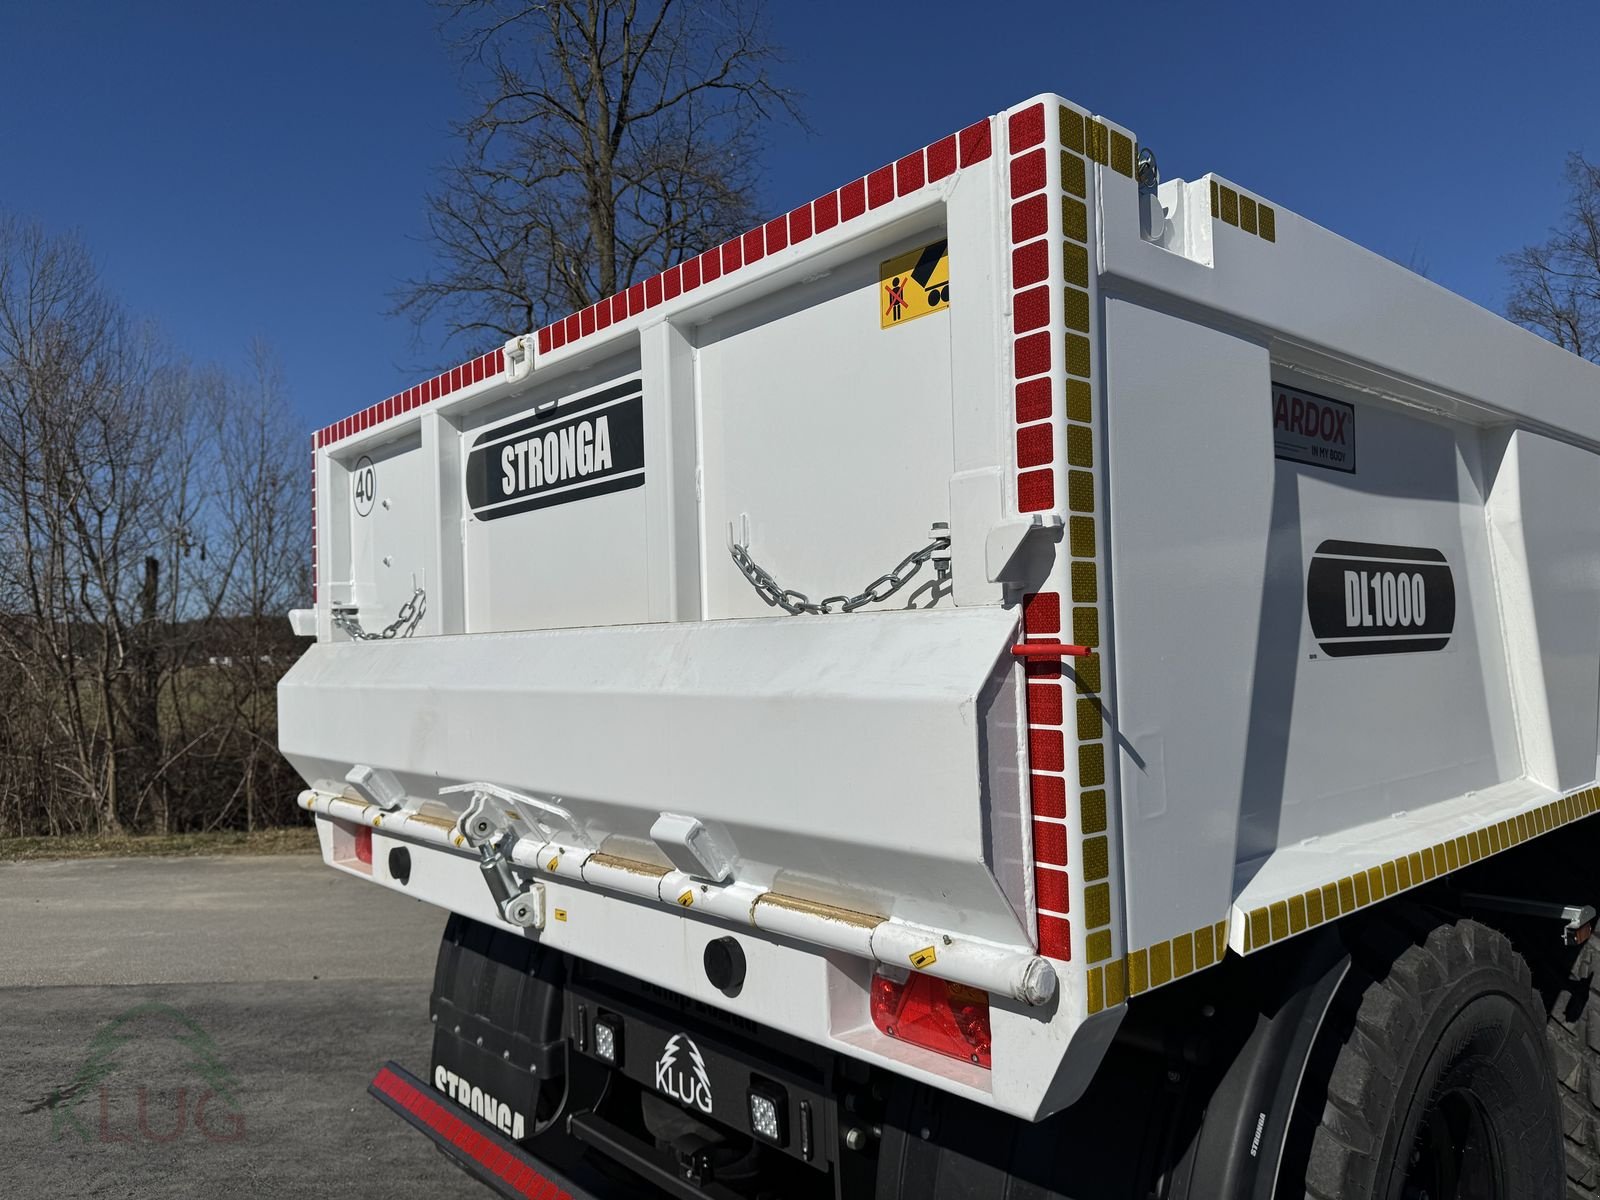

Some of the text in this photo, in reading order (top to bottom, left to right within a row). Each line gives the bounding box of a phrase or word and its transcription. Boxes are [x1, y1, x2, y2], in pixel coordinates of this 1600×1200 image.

[1272, 391, 1346, 445] ARDOX
[501, 415, 613, 495] STRONGA
[1312, 445, 1346, 462] IN MY BODY
[356, 468, 373, 503] 40
[1344, 570, 1426, 627] DL1000
[434, 1065, 525, 1140] STRONGA
[656, 1061, 713, 1113] KLUG
[1250, 1112, 1266, 1157] STRONGA
